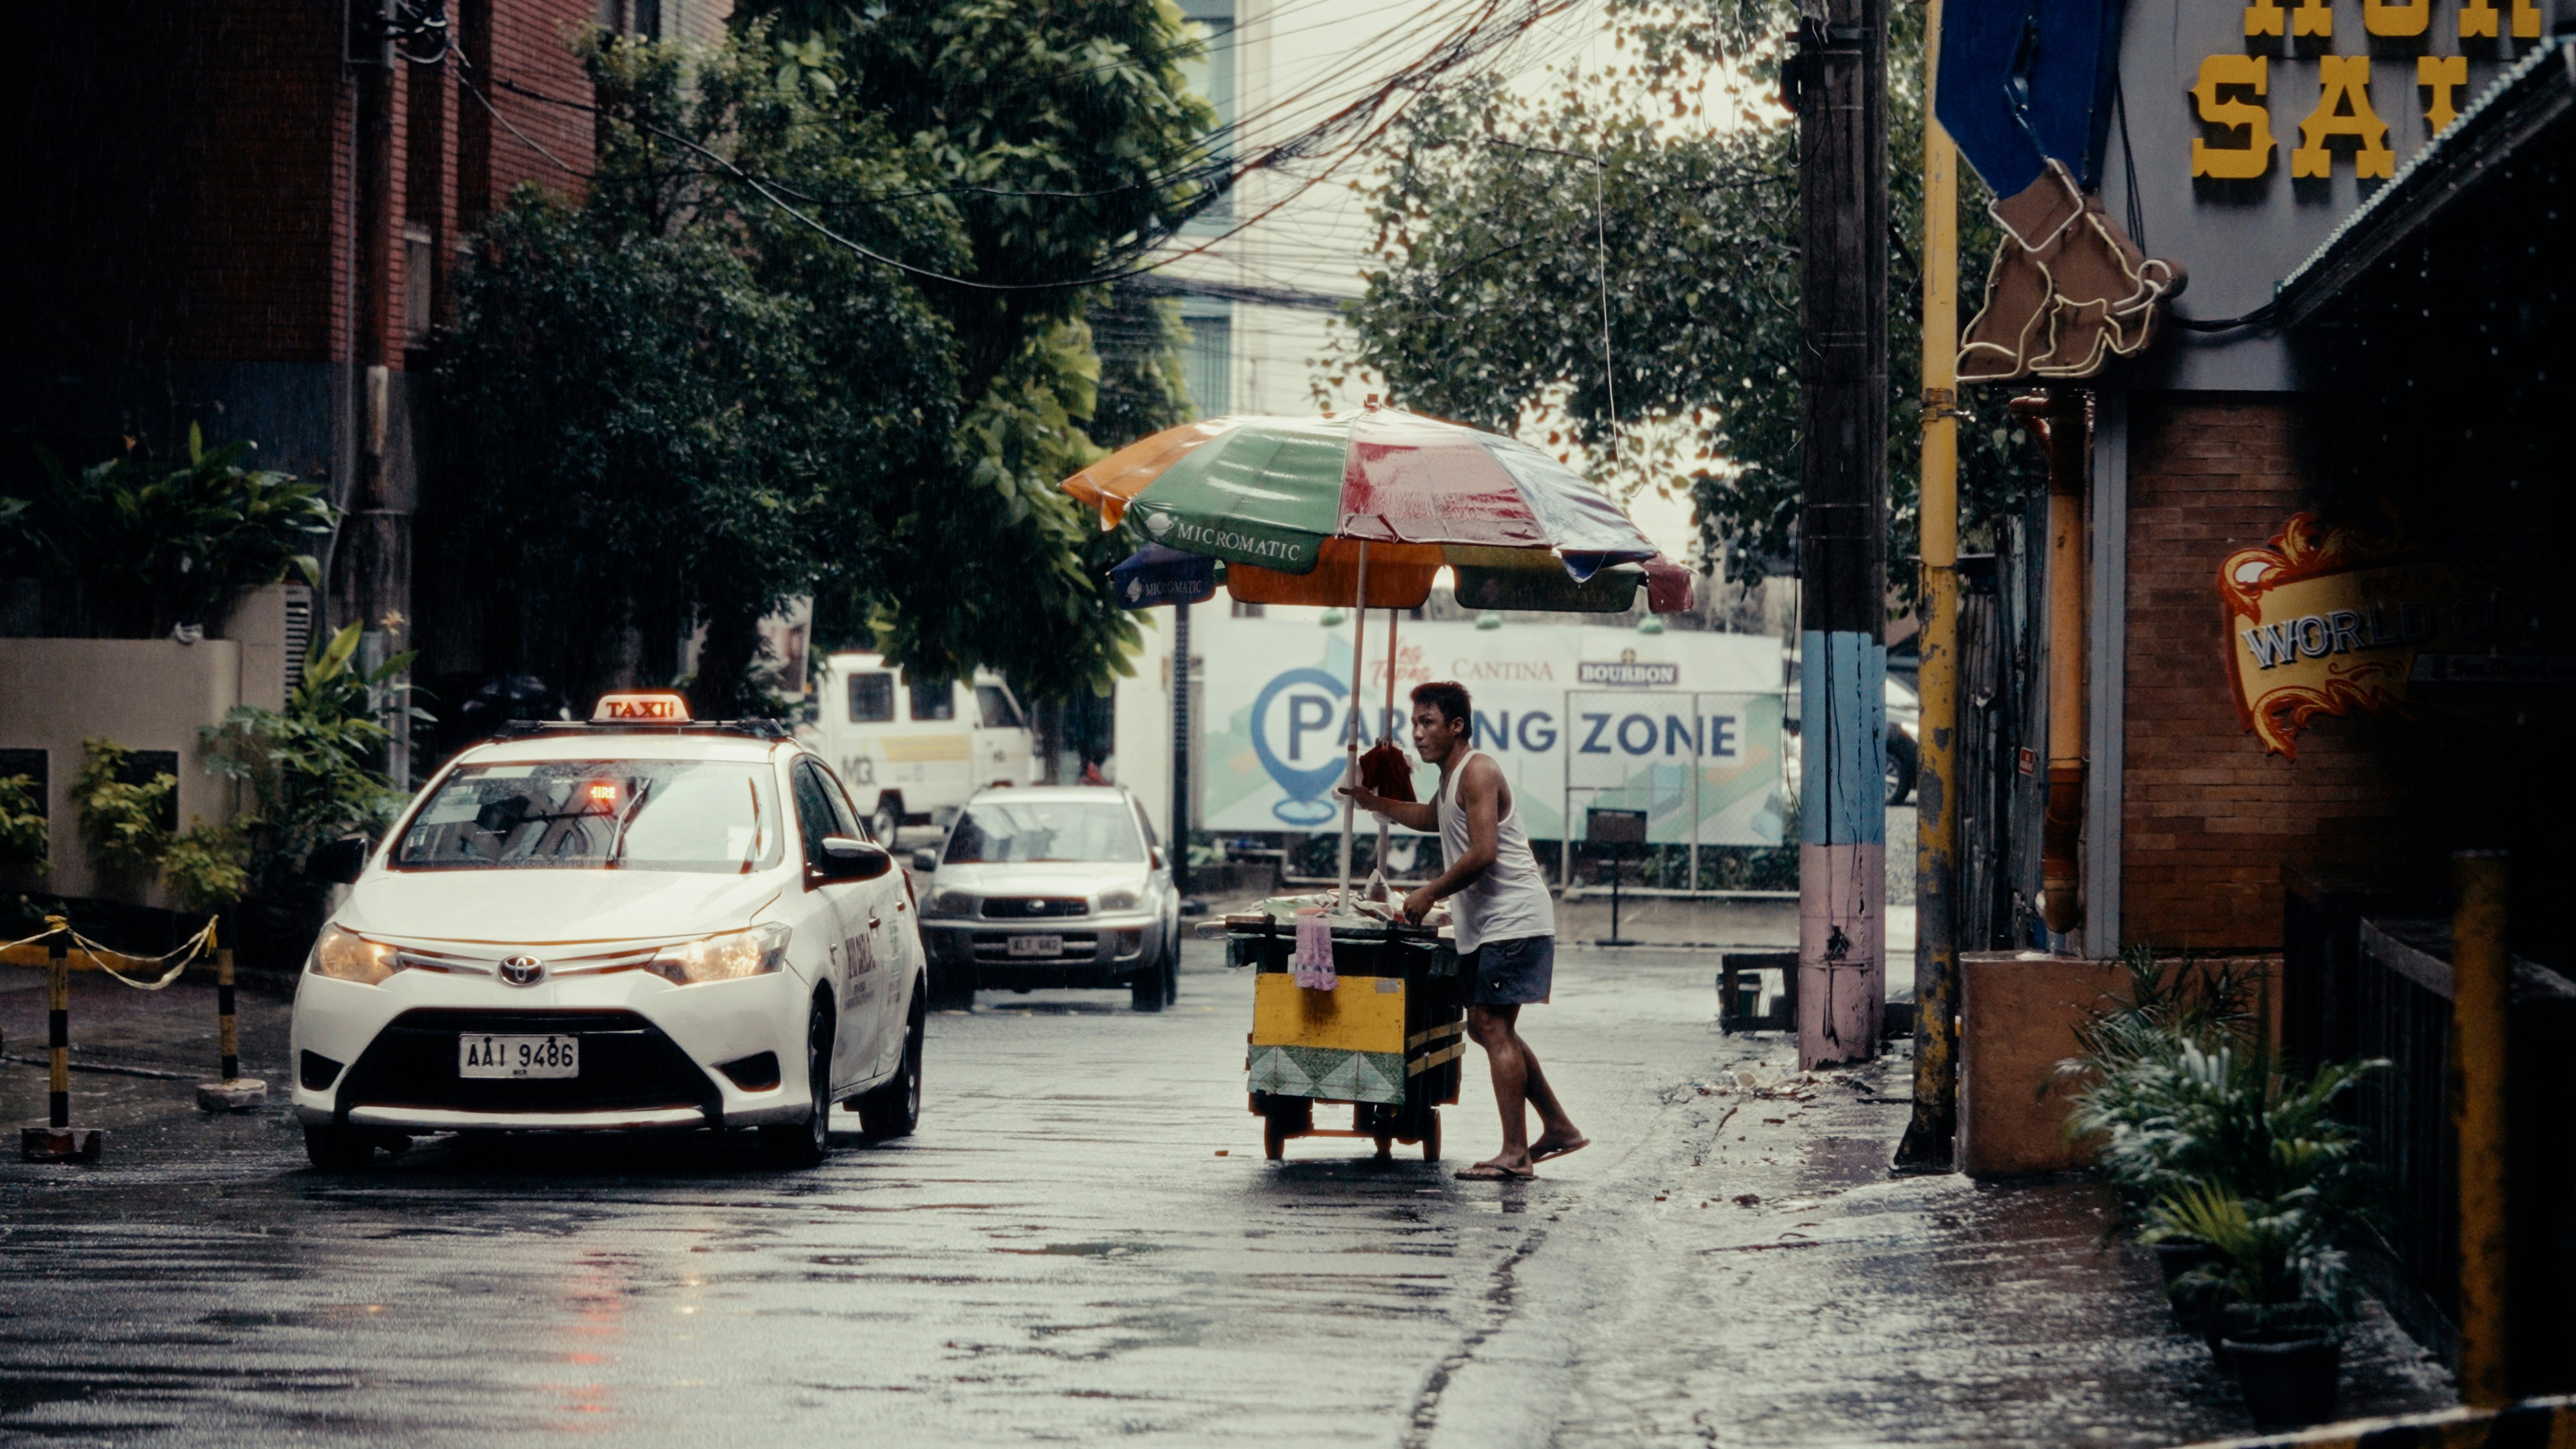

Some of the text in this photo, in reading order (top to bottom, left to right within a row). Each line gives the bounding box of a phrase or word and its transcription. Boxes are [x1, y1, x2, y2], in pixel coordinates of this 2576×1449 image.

[1177, 523, 1301, 561] MICROMATIC
[1145, 580, 1202, 596] MICROMATIC
[2241, 602, 2437, 670] WORLD
[1451, 658, 1554, 682] CANTINA
[1580, 665, 1676, 684] BOURBON
[606, 702, 668, 718] TAXI
[1289, 695, 1737, 760] PARNG ZONE
[519, 1043, 574, 1067] 9486
